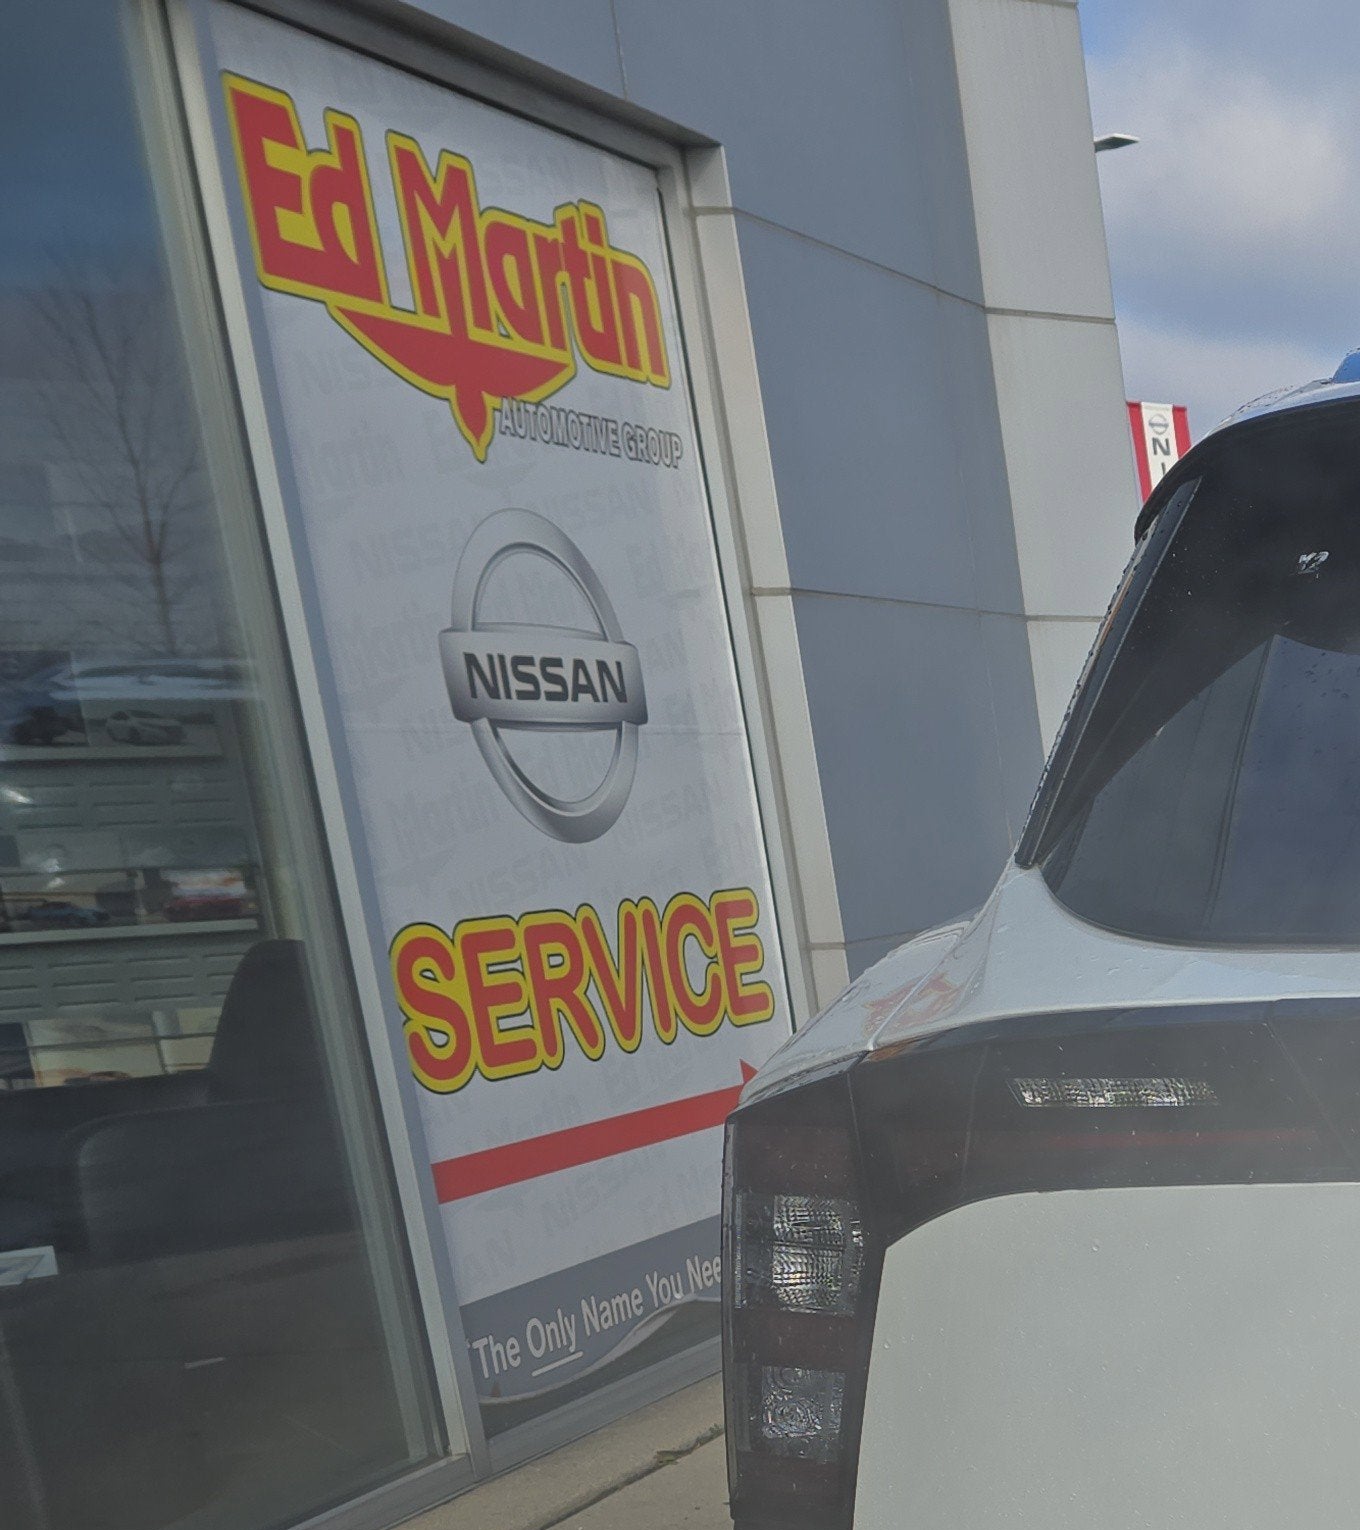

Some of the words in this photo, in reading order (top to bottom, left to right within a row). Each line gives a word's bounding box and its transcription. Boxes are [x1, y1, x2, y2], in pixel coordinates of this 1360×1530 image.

[222, 70, 389, 306] Ed
[387, 130, 671, 388] Martin
[500, 396, 621, 457] AUTOMOTIVE
[620, 421, 683, 469] GROUP
[462, 652, 628, 704] NISSAN
[390, 887, 774, 1094] SERVICE
[525, 1308, 576, 1359] Only
[580, 1286, 644, 1337] Name
[645, 1270, 685, 1309] You
[686, 1254, 722, 1294] Nee
